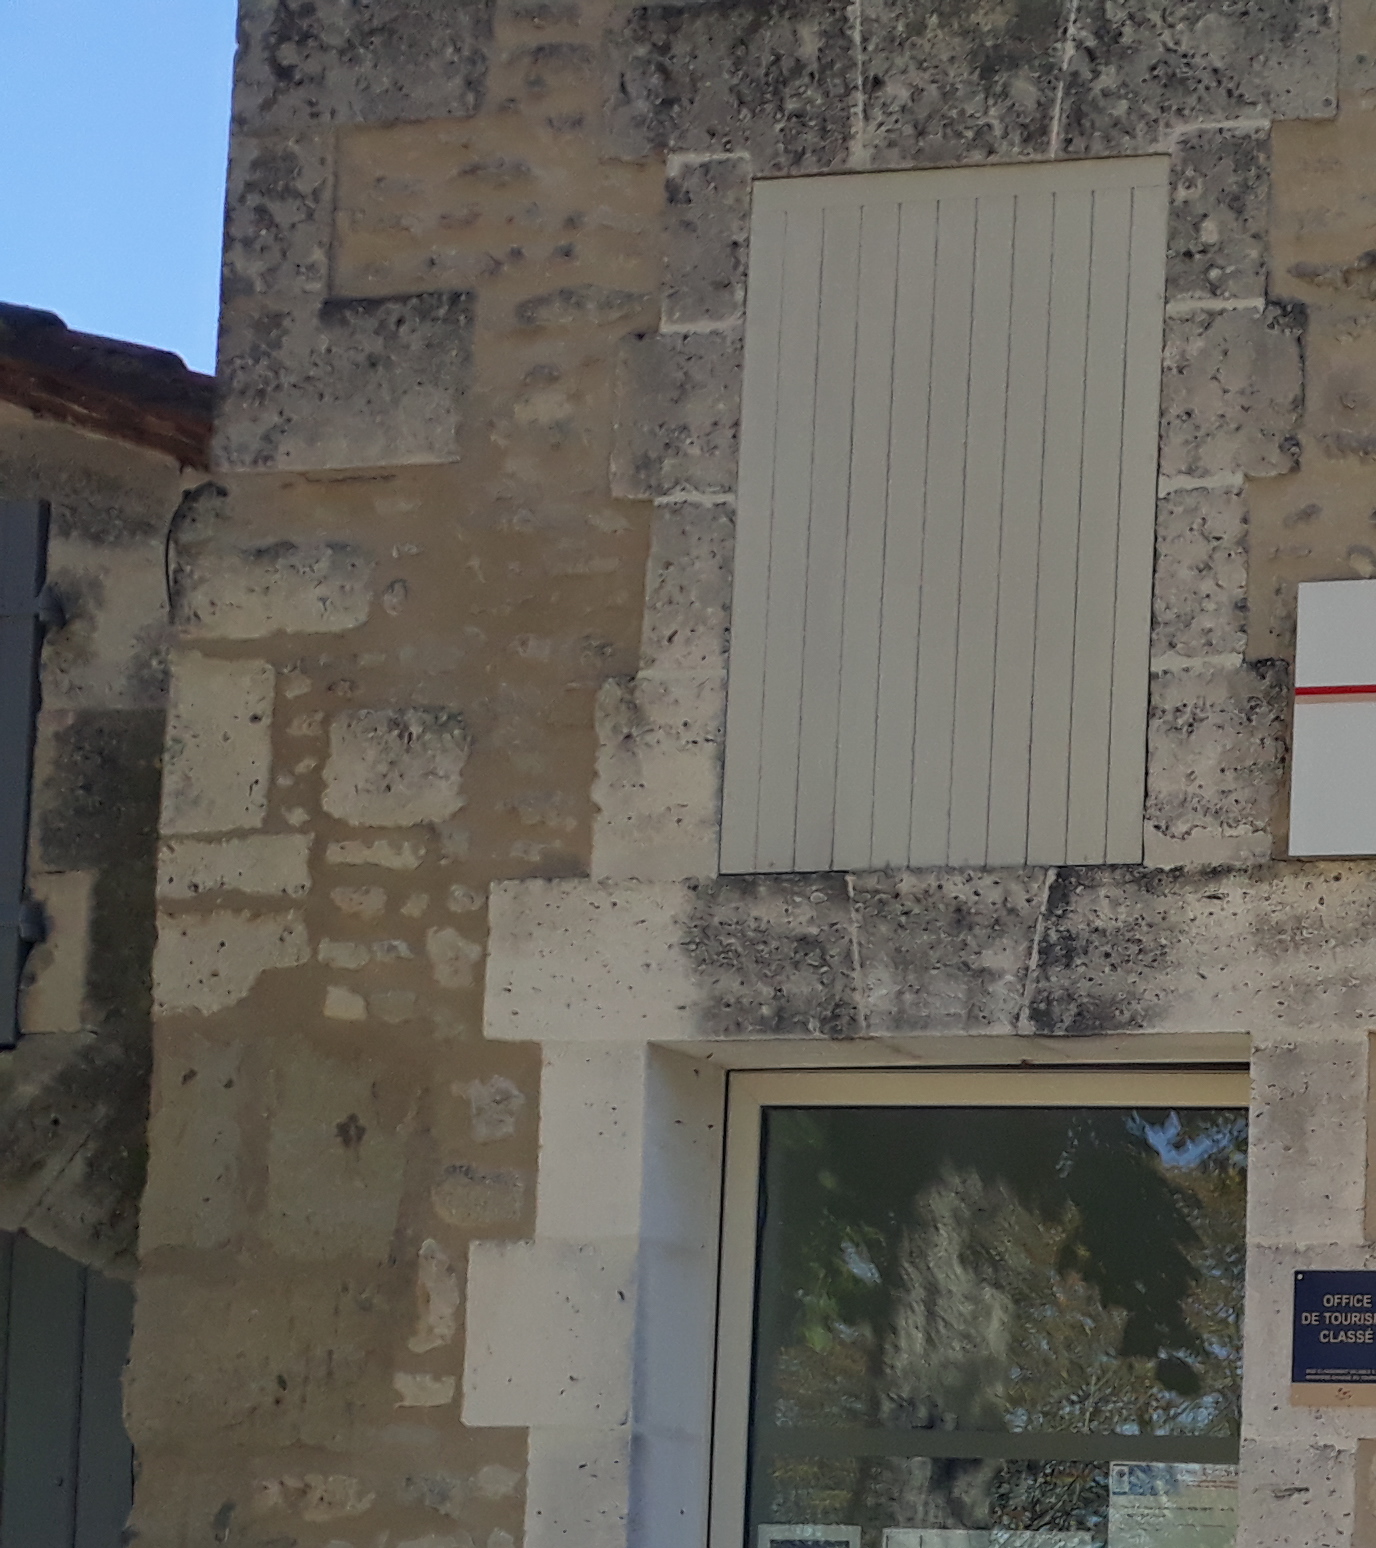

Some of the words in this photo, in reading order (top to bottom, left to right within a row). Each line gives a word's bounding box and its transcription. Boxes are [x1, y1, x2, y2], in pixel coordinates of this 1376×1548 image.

[1323, 1294, 1373, 1308] OFFICE
[1301, 1312, 1320, 1325] DE
[1319, 1328, 1374, 1344] CLASSÉ
